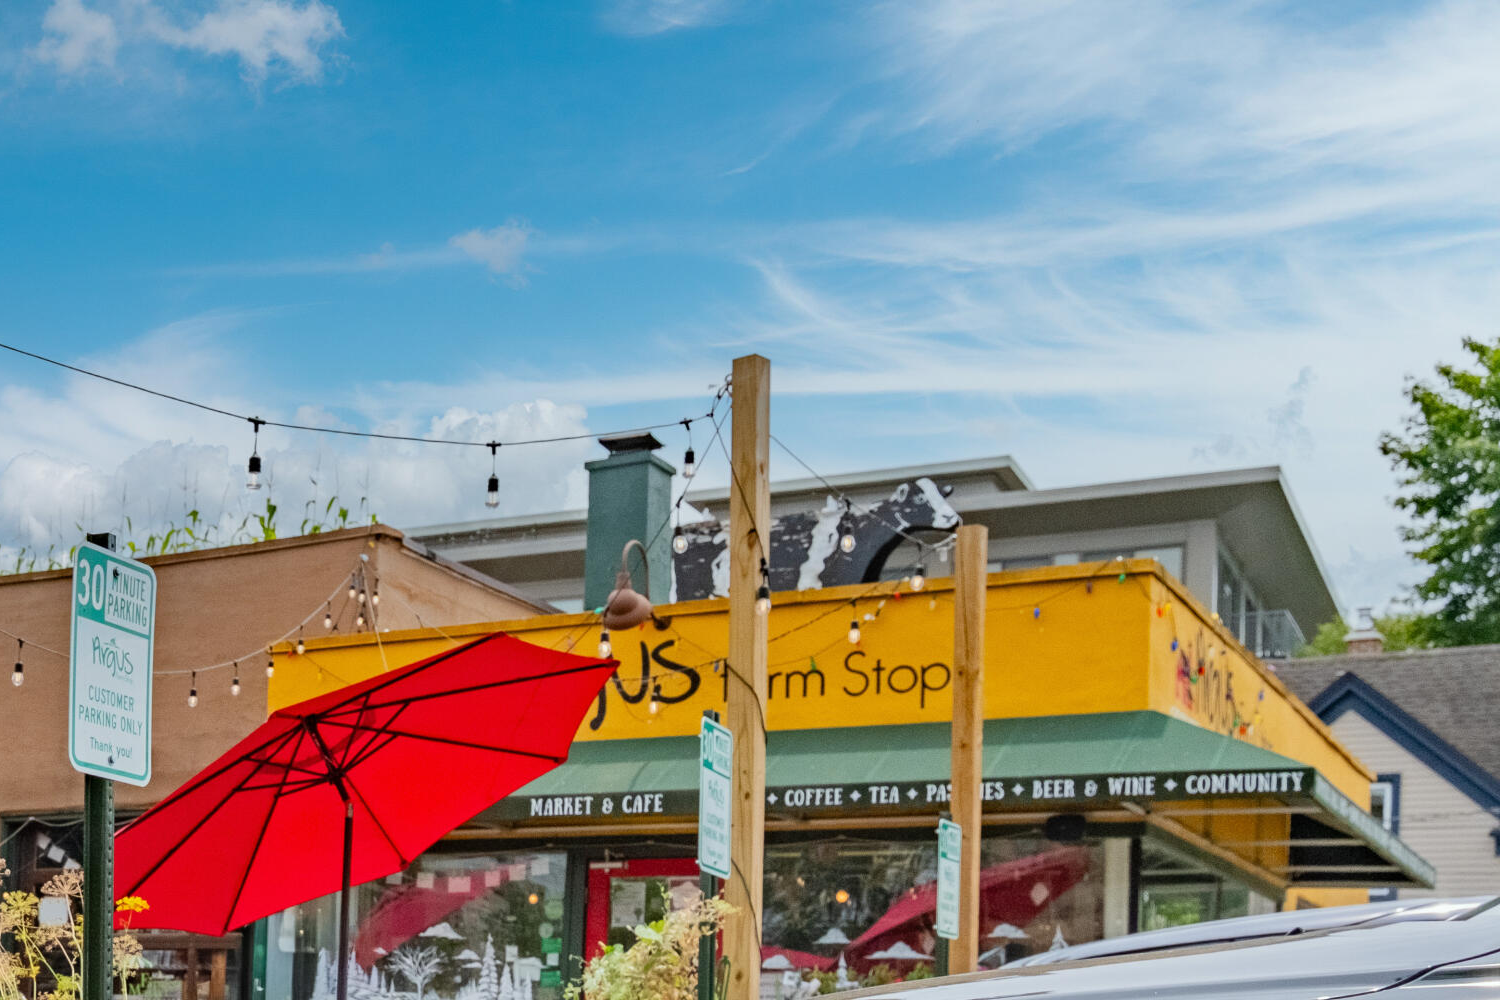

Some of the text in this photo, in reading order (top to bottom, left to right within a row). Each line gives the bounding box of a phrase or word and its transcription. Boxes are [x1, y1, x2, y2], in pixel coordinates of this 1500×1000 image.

[77, 558, 105, 611] 30
[112, 569, 147, 602] MINUTE
[107, 593, 148, 628] PARKING
[720, 650, 951, 709] frm Stop
[88, 685, 135, 713] CUSTOMER
[78, 704, 143, 737] PARKING ONLY
[90, 736, 133, 760] Thank you!
[530, 796, 594, 817] MARKET
[601, 797, 614, 815] &
[621, 793, 664, 814] CAFE
[784, 787, 844, 807] COFFEE
[868, 785, 900, 804] TEA
[1032, 778, 1076, 799] BEER
[1084, 779, 1098, 797] &
[1107, 775, 1156, 796] WINE
[1185, 771, 1305, 794] COMMUNITY
